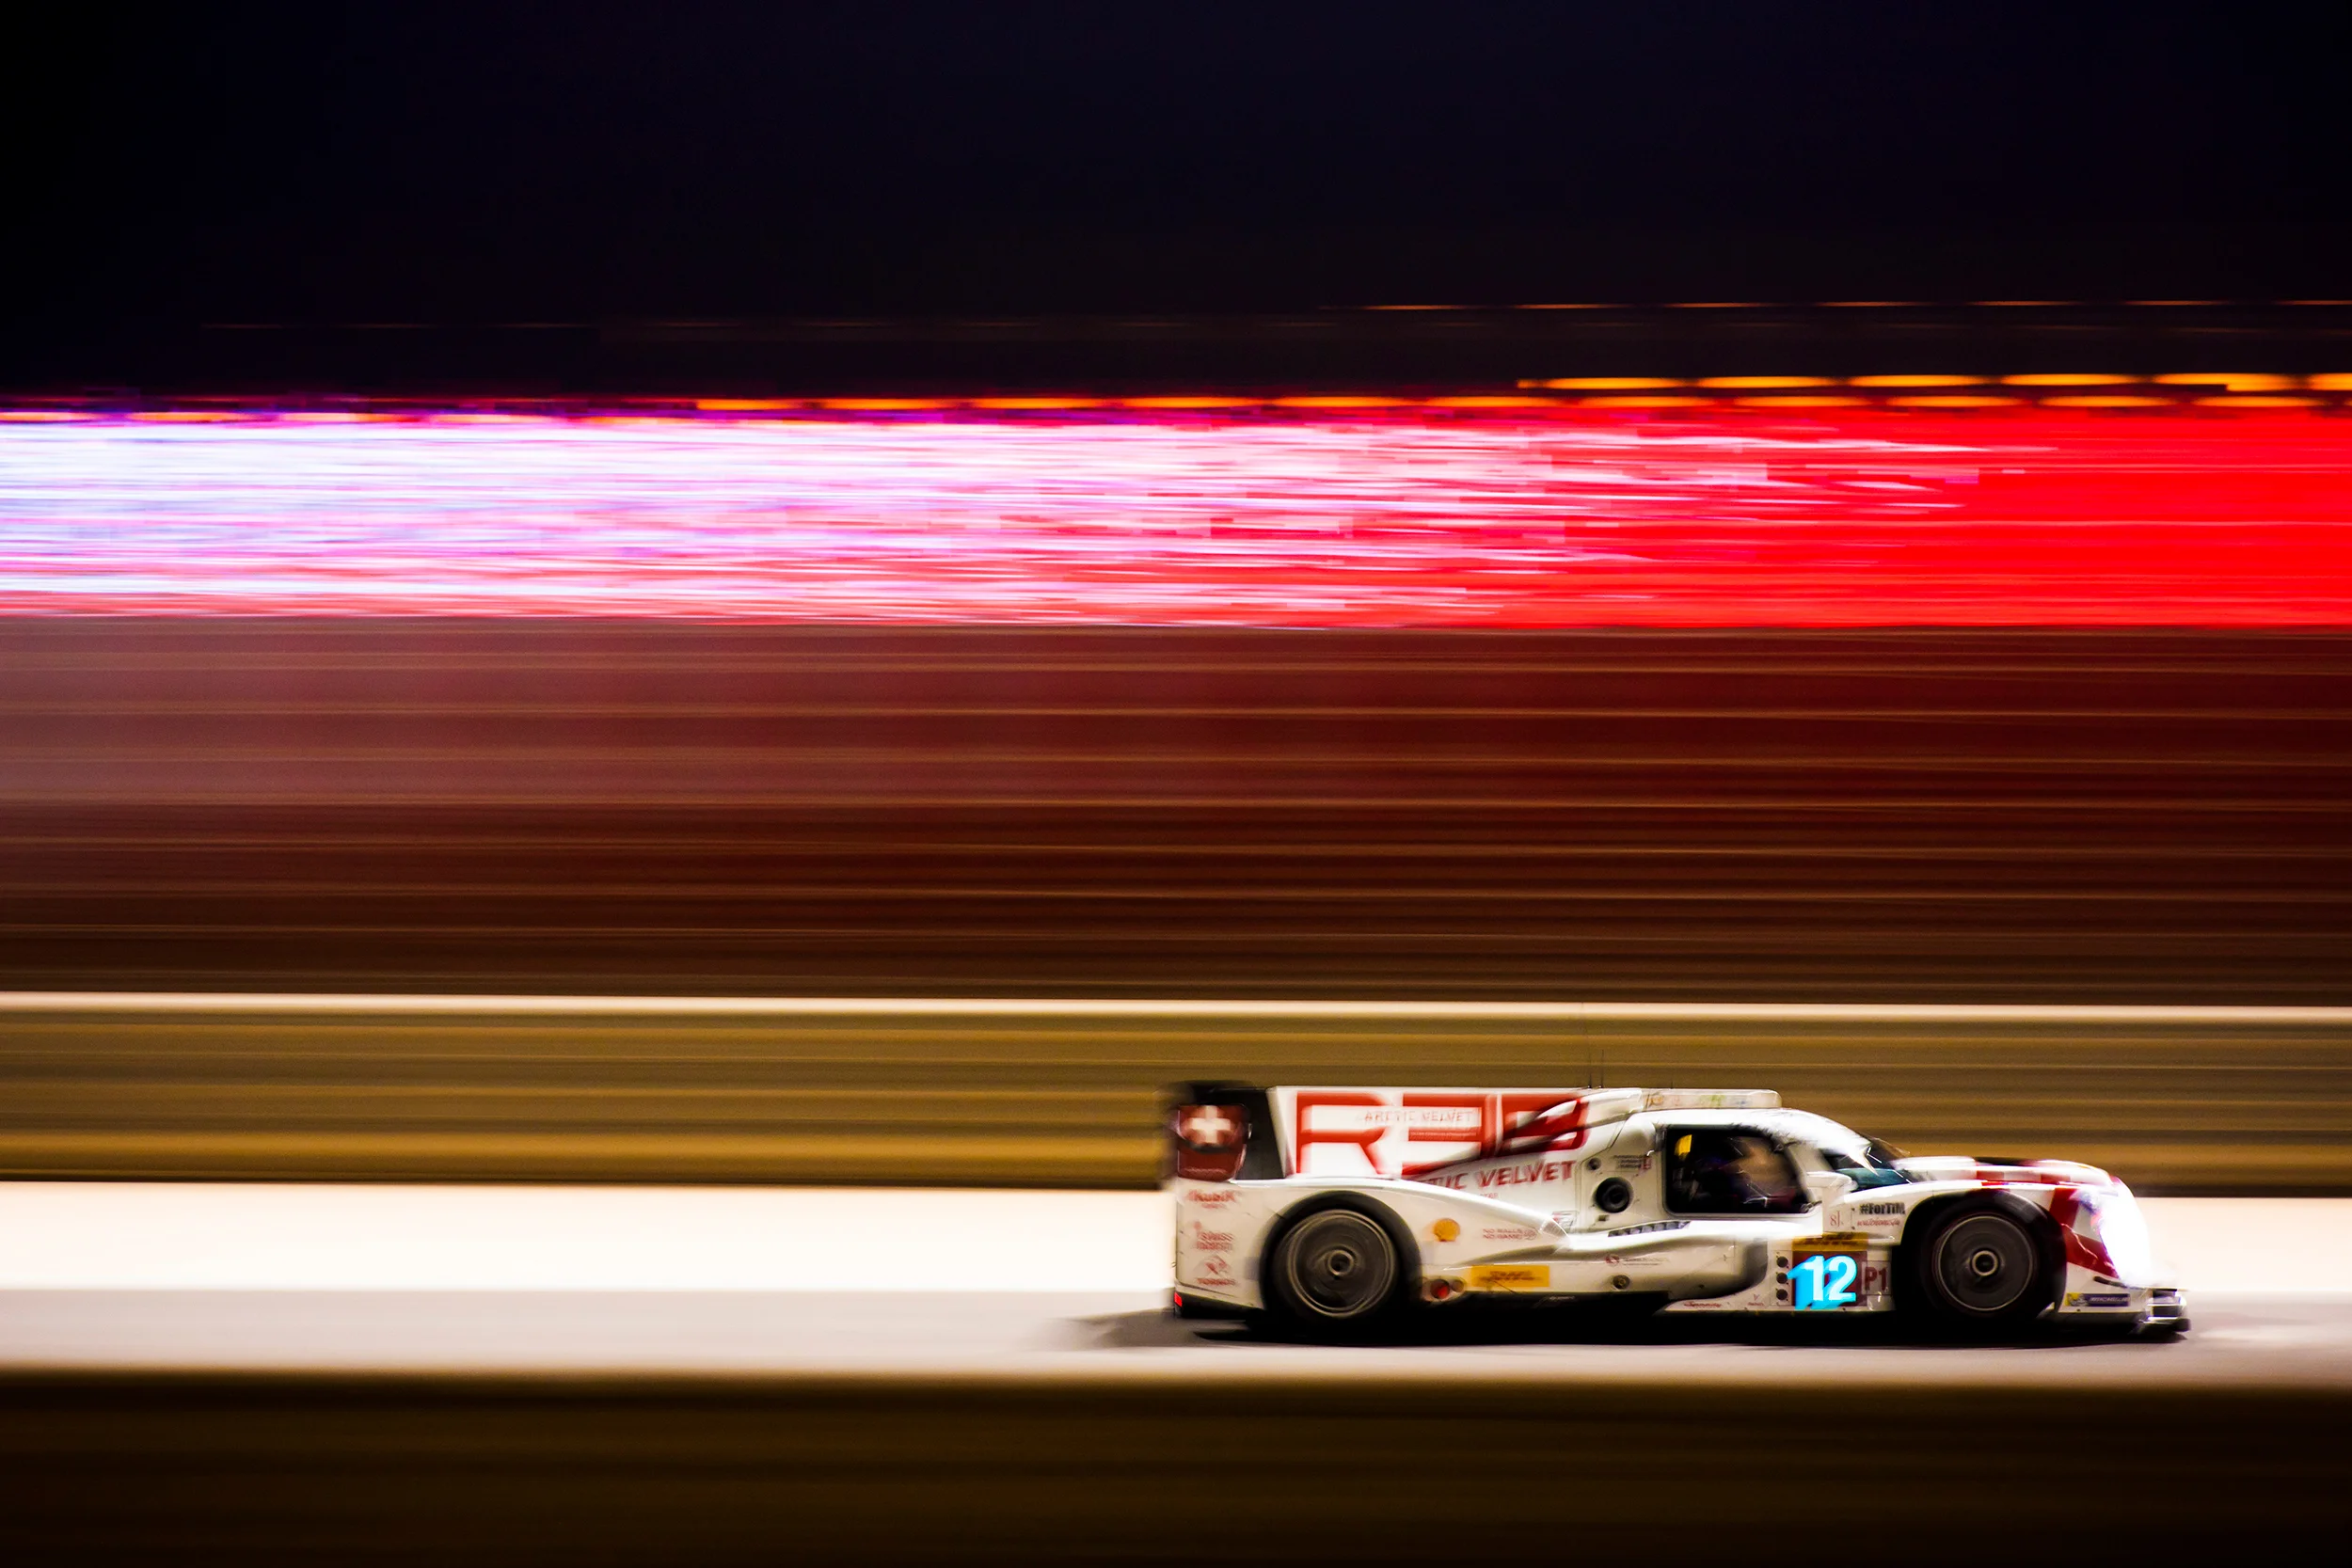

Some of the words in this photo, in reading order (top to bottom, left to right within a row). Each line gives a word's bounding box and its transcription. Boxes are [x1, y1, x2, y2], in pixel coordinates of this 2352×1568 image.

[1364, 1110, 1417, 1122] ARCTIC
[1422, 1110, 1473, 1122] VELVET
[1478, 1160, 1577, 1188] VELVET
[1791, 1255, 1857, 1307] 12
[1865, 1267, 1887, 1291] P1
